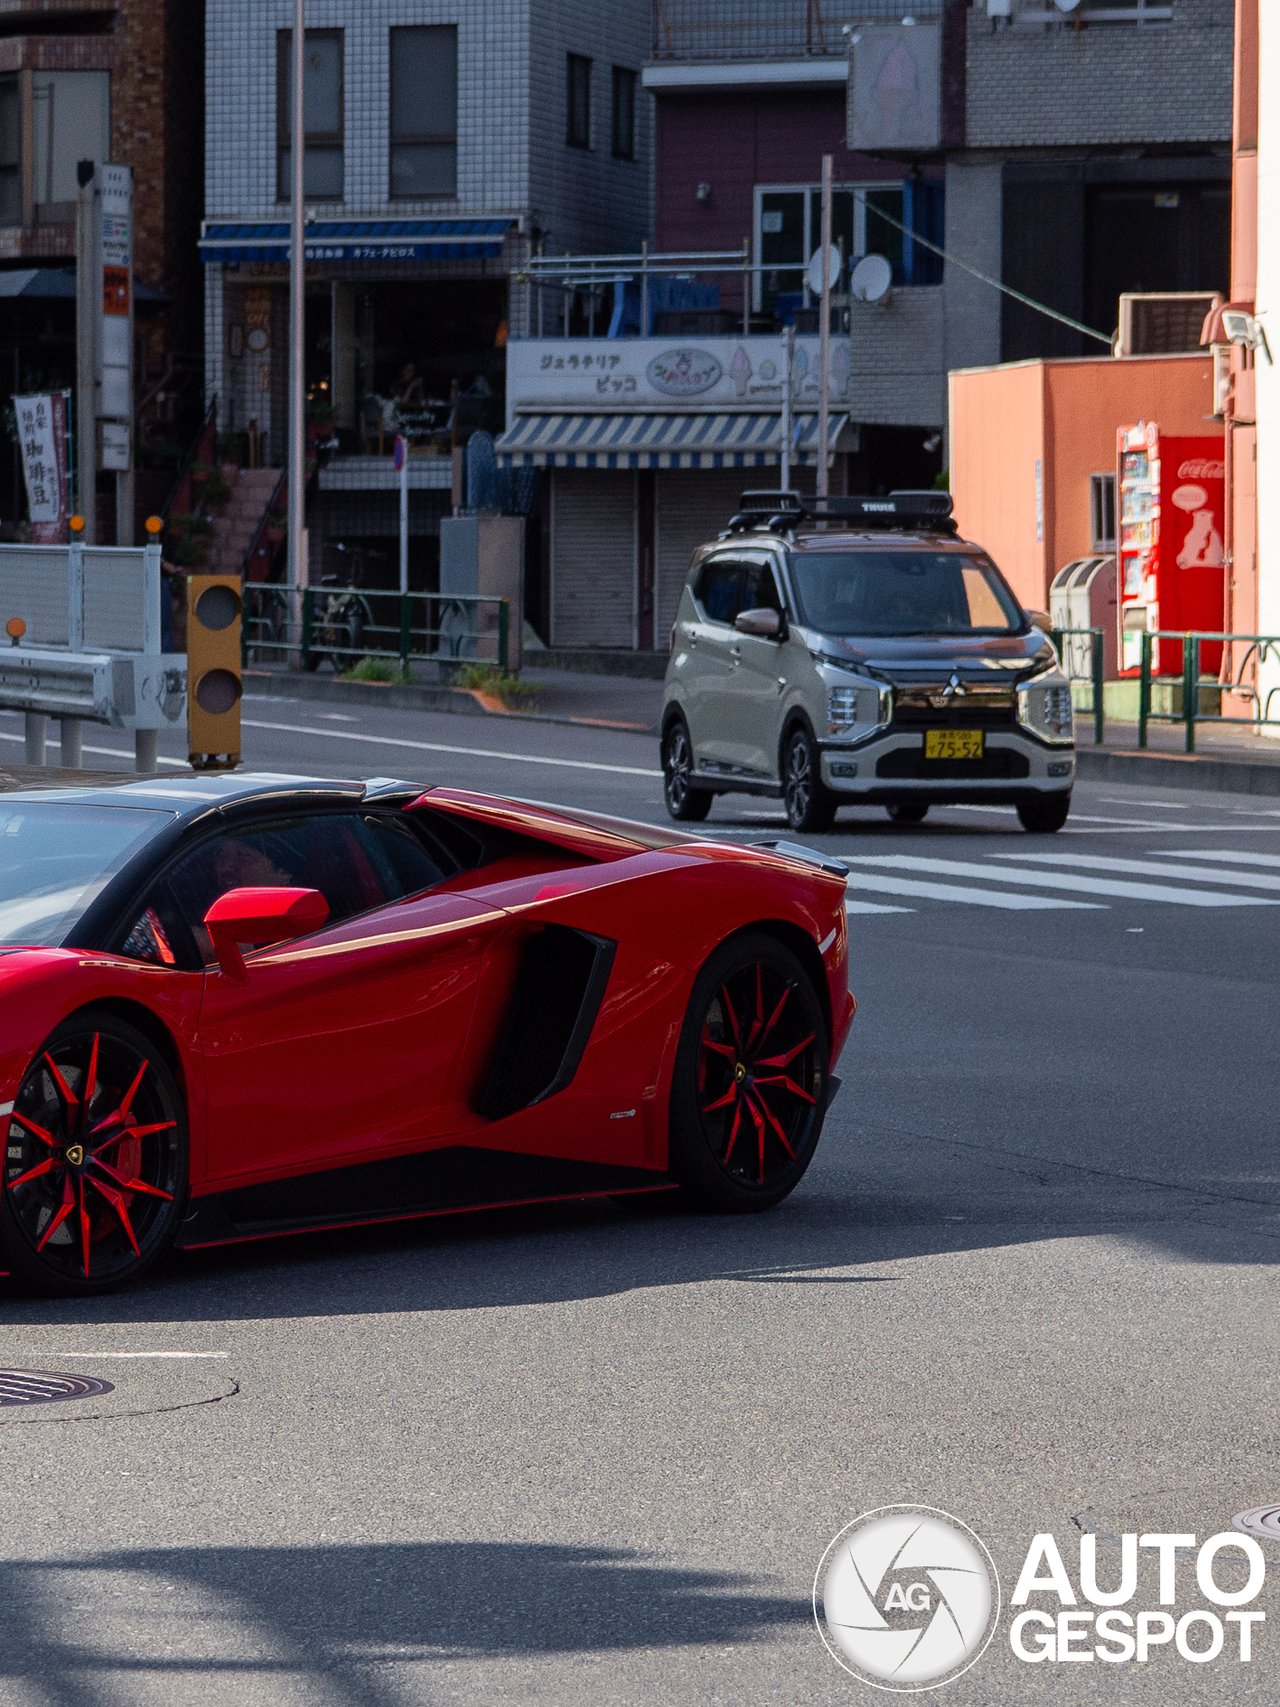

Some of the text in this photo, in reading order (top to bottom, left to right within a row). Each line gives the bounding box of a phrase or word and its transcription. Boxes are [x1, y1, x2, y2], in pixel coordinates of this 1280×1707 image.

[540, 355, 620, 370] ジェラテリア
[26, 440, 49, 506] 珈琲豆
[937, 742, 981, 757] 75-52
